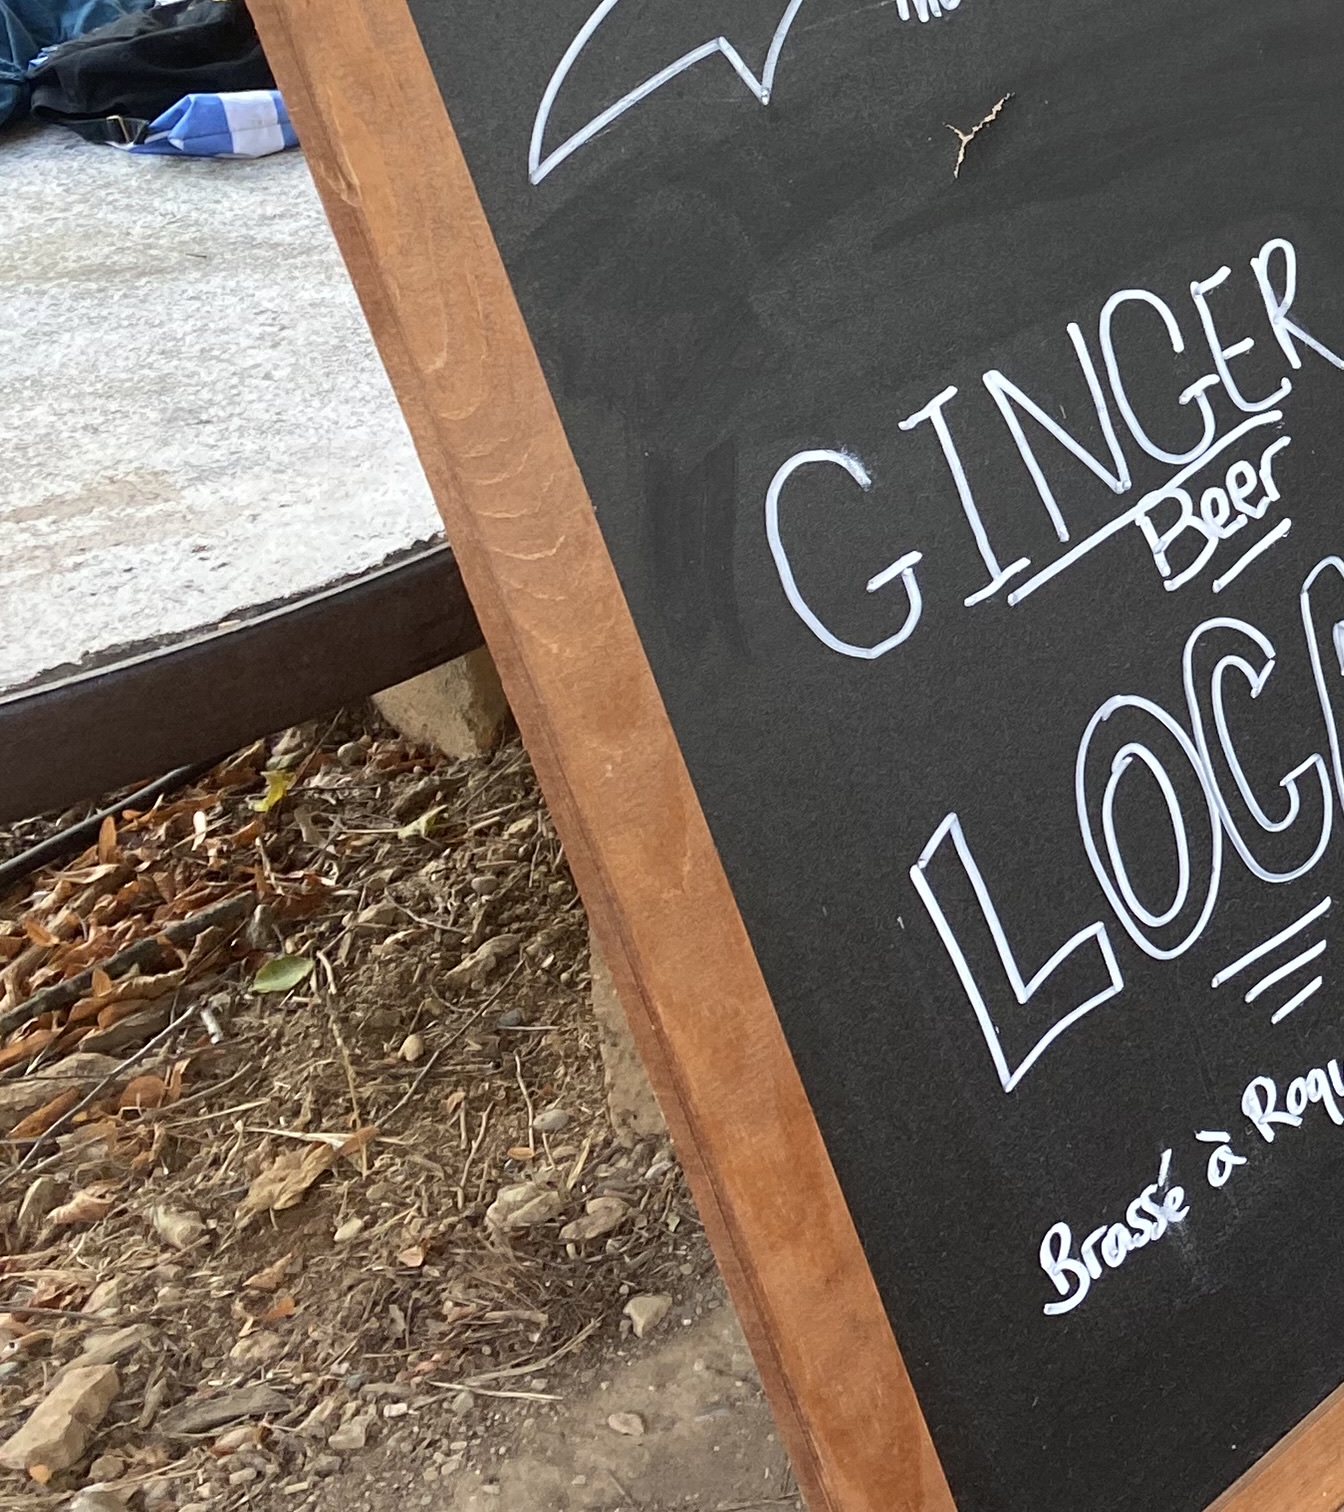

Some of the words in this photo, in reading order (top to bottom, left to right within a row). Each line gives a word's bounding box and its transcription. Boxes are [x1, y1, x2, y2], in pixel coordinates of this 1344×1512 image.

[1134, 434, 1292, 593] Beer
[1040, 1149, 1190, 1315] Brassé
[1196, 1131, 1247, 1188] à
